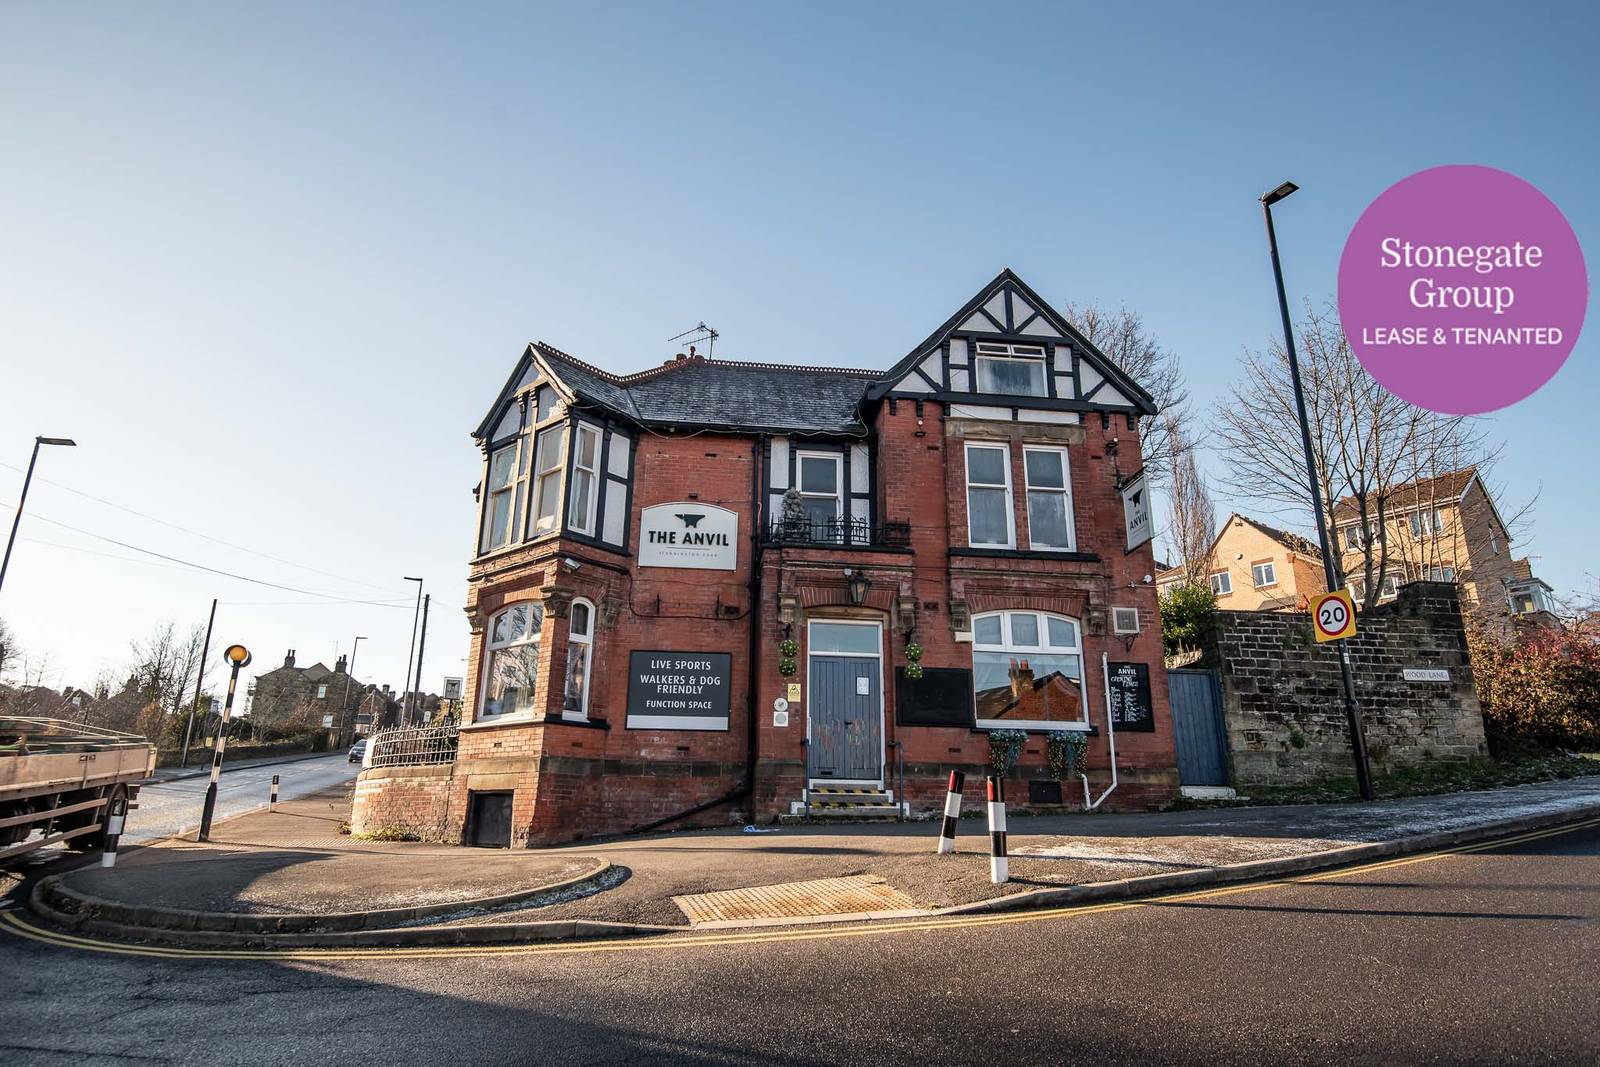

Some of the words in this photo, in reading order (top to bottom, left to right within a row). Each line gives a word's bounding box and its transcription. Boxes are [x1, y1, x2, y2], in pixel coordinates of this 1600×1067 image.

[1130, 511, 1148, 531] ANVIL
[648, 530, 677, 544] THE
[682, 532, 729, 546] ANVIL
[1321, 606, 1345, 626] 20
[651, 660, 672, 669] LIVE
[675, 661, 711, 671] SPORTS
[640, 674, 686, 685] WALKERS
[689, 675, 696, 685] &
[700, 676, 721, 686] DOG
[1404, 671, 1426, 679] WOOD
[1428, 671, 1445, 679] LANE
[657, 684, 704, 695] FRIENDLY
[646, 700, 686, 709] FUNCTION
[688, 701, 713, 710] SPACE
